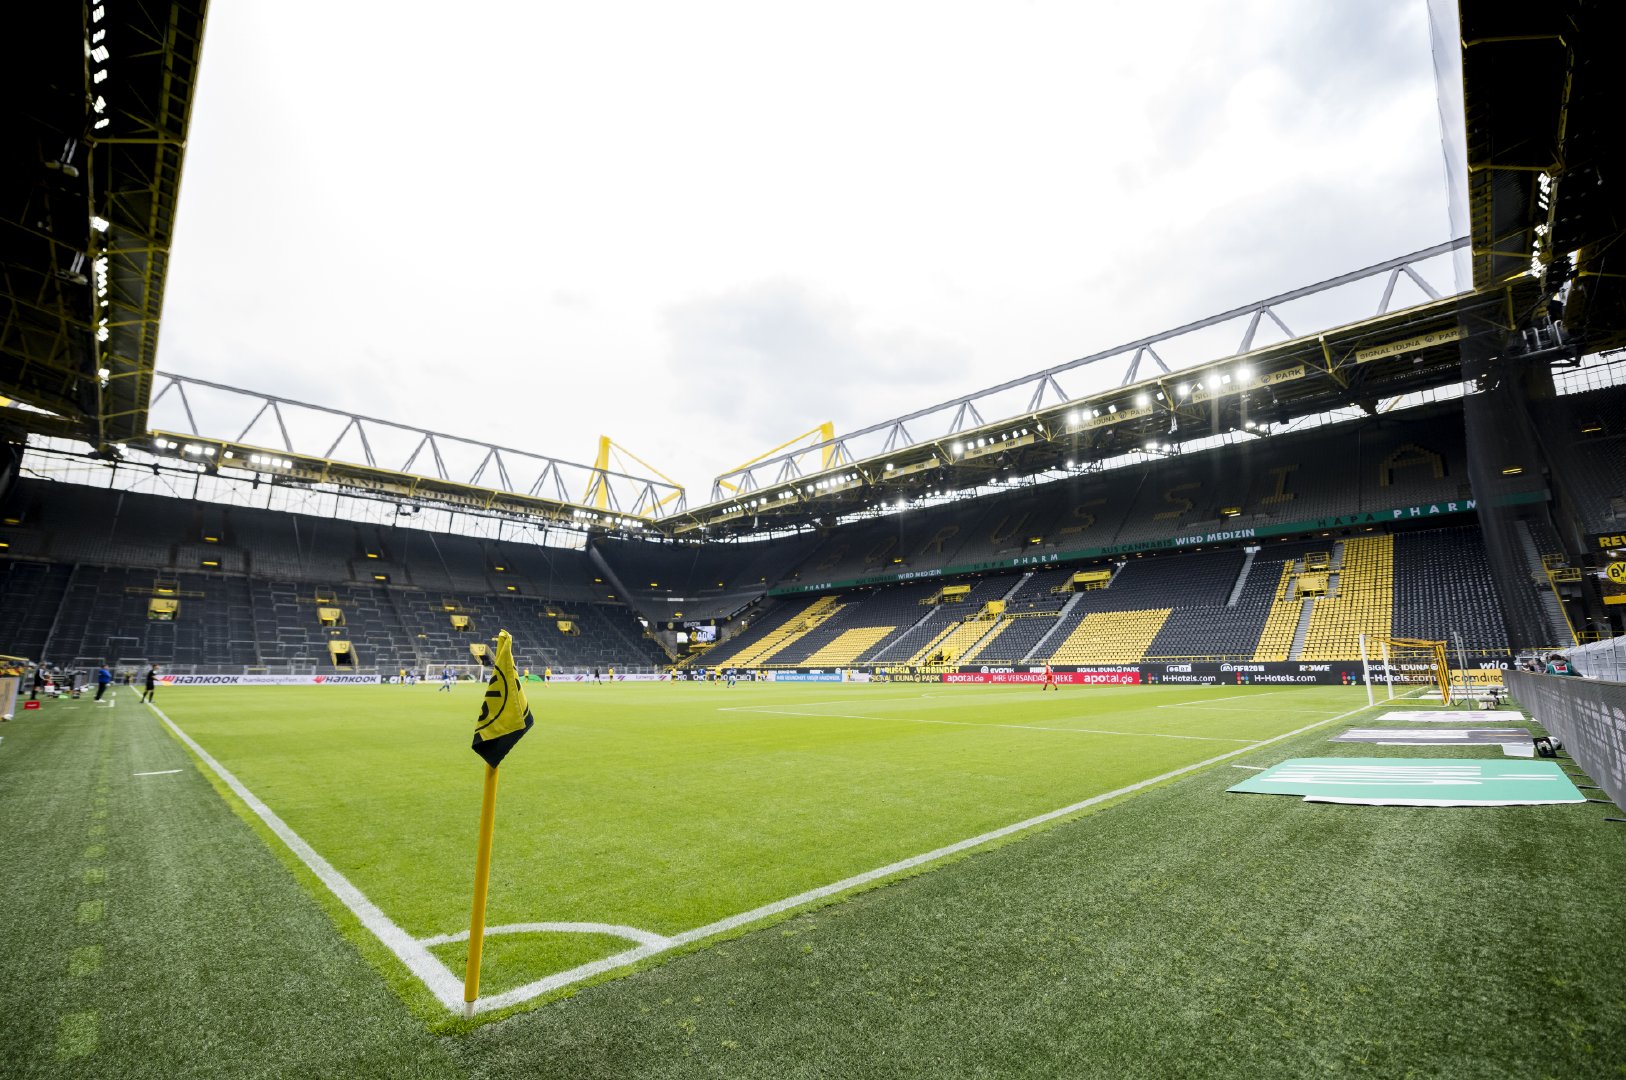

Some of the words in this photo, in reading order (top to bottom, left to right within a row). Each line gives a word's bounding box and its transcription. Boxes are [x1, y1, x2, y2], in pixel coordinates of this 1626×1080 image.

[1359, 347, 1391, 360] SIGNAL
[1393, 339, 1421, 353] IDUNA
[1275, 369, 1302, 380] PARK
[1317, 513, 1377, 528] HAPA
[1121, 539, 1173, 551] CANNABIS
[1175, 535, 1204, 546] WIRD
[1206, 528, 1255, 543] MEDIZIN
[1013, 553, 1059, 566] PHARM
[897, 571, 914, 580] WIRD
[914, 568, 942, 578] MEDIZIN
[804, 582, 832, 592] PHARM
[916, 666, 960, 674] VERBINDET
[1480, 660, 1508, 670] wilo
[174, 675, 240, 684] HANKOOK
[325, 675, 377, 684] HANKOOK
[921, 673, 941, 682] PARK
[947, 674, 984, 683] apotal.de
[1007, 674, 1073, 683] VERSANDAPTHEKE
[1084, 673, 1133, 685] apotal.de
[1162, 674, 1217, 682] H-Hotels.com
[1254, 674, 1317, 682] H-Hotels.com
